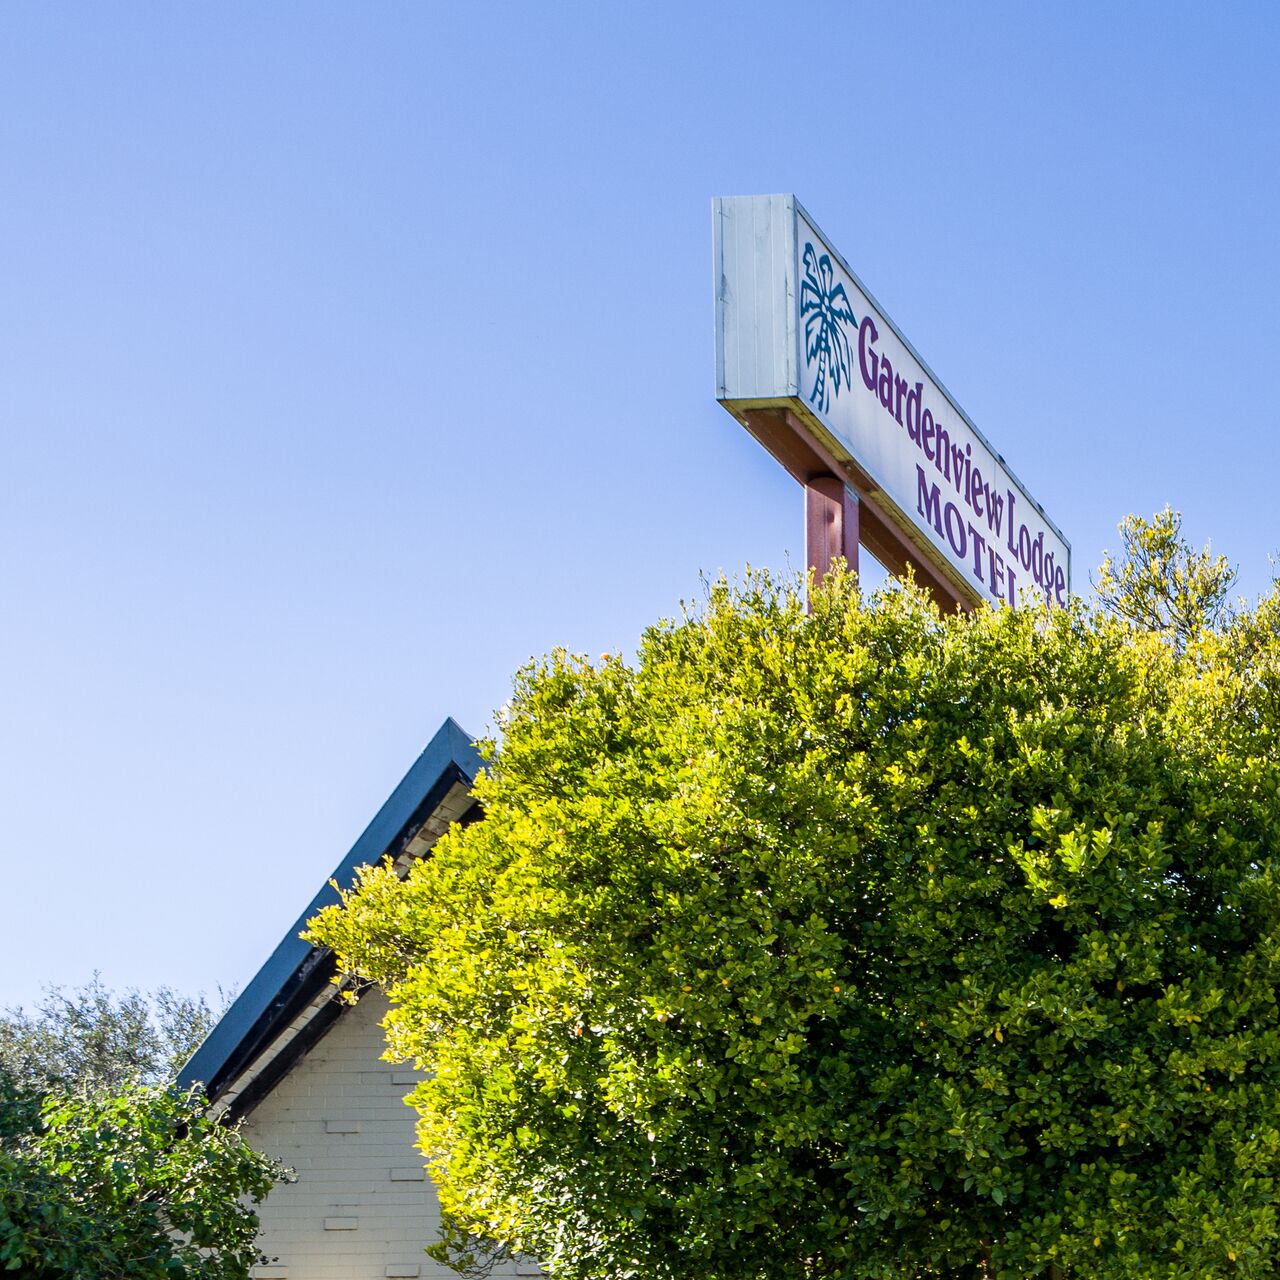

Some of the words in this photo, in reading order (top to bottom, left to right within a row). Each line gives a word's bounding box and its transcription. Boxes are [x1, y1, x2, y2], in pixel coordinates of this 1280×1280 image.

[858, 315, 1004, 538] Gardenview
[1007, 488, 1065, 610] Lodge
[915, 462, 1017, 614] MOTEL
